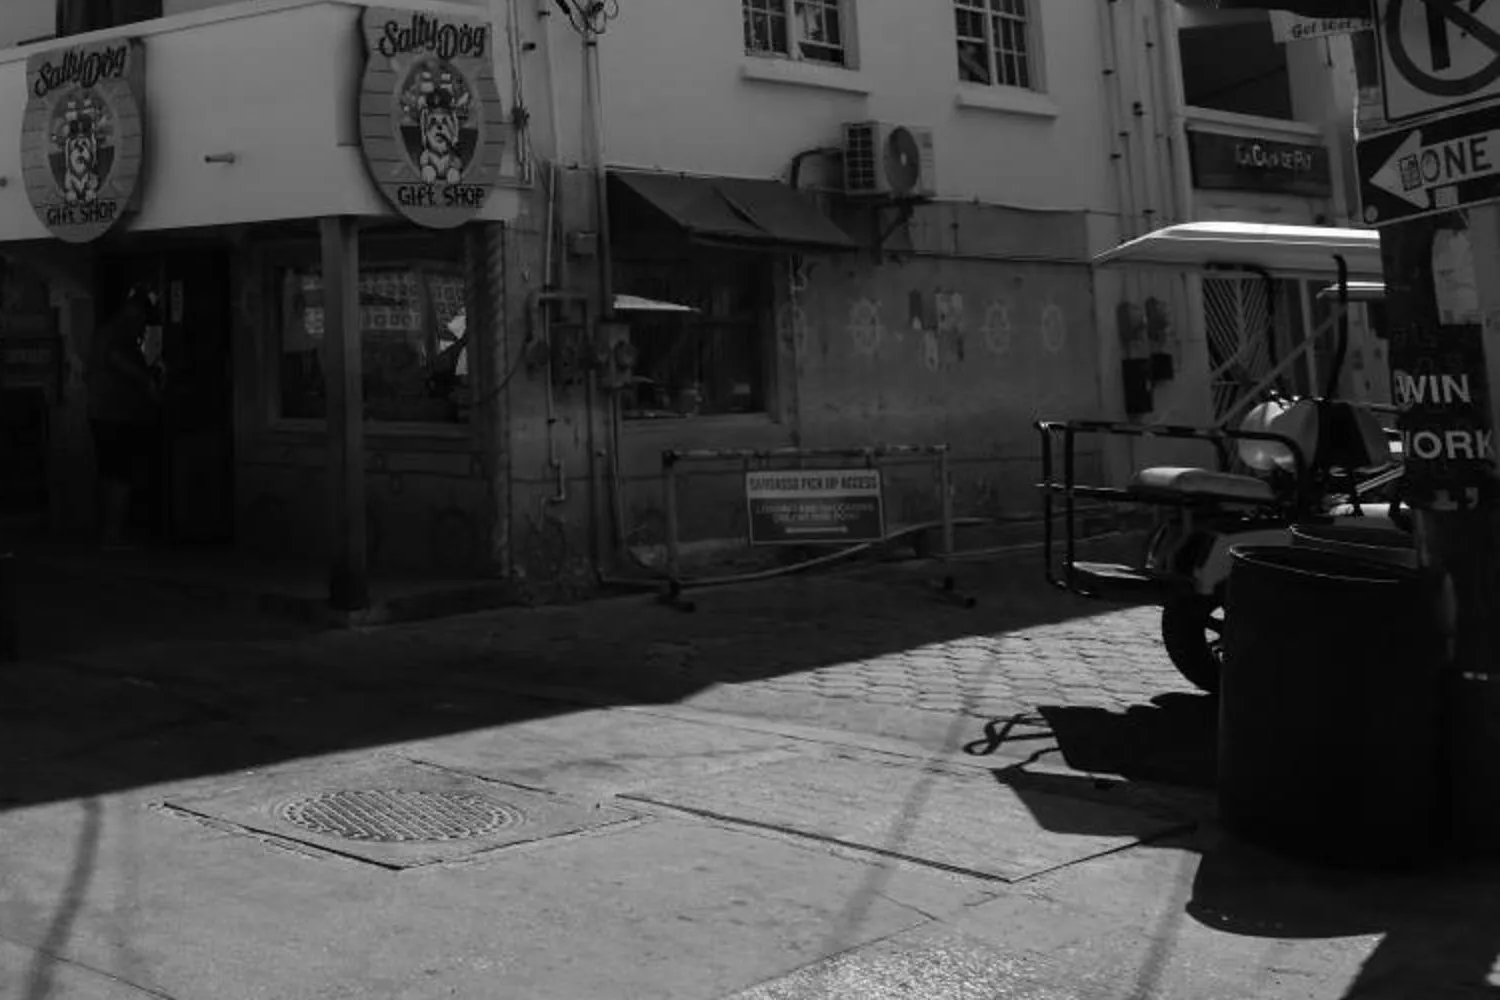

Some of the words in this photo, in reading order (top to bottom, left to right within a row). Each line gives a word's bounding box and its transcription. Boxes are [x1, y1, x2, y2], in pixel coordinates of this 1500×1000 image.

[380, 13, 438, 58] Salty
[437, 23, 486, 60] Dog
[1420, 135, 1493, 183] ONE
[1403, 429, 1497, 460] ORK
